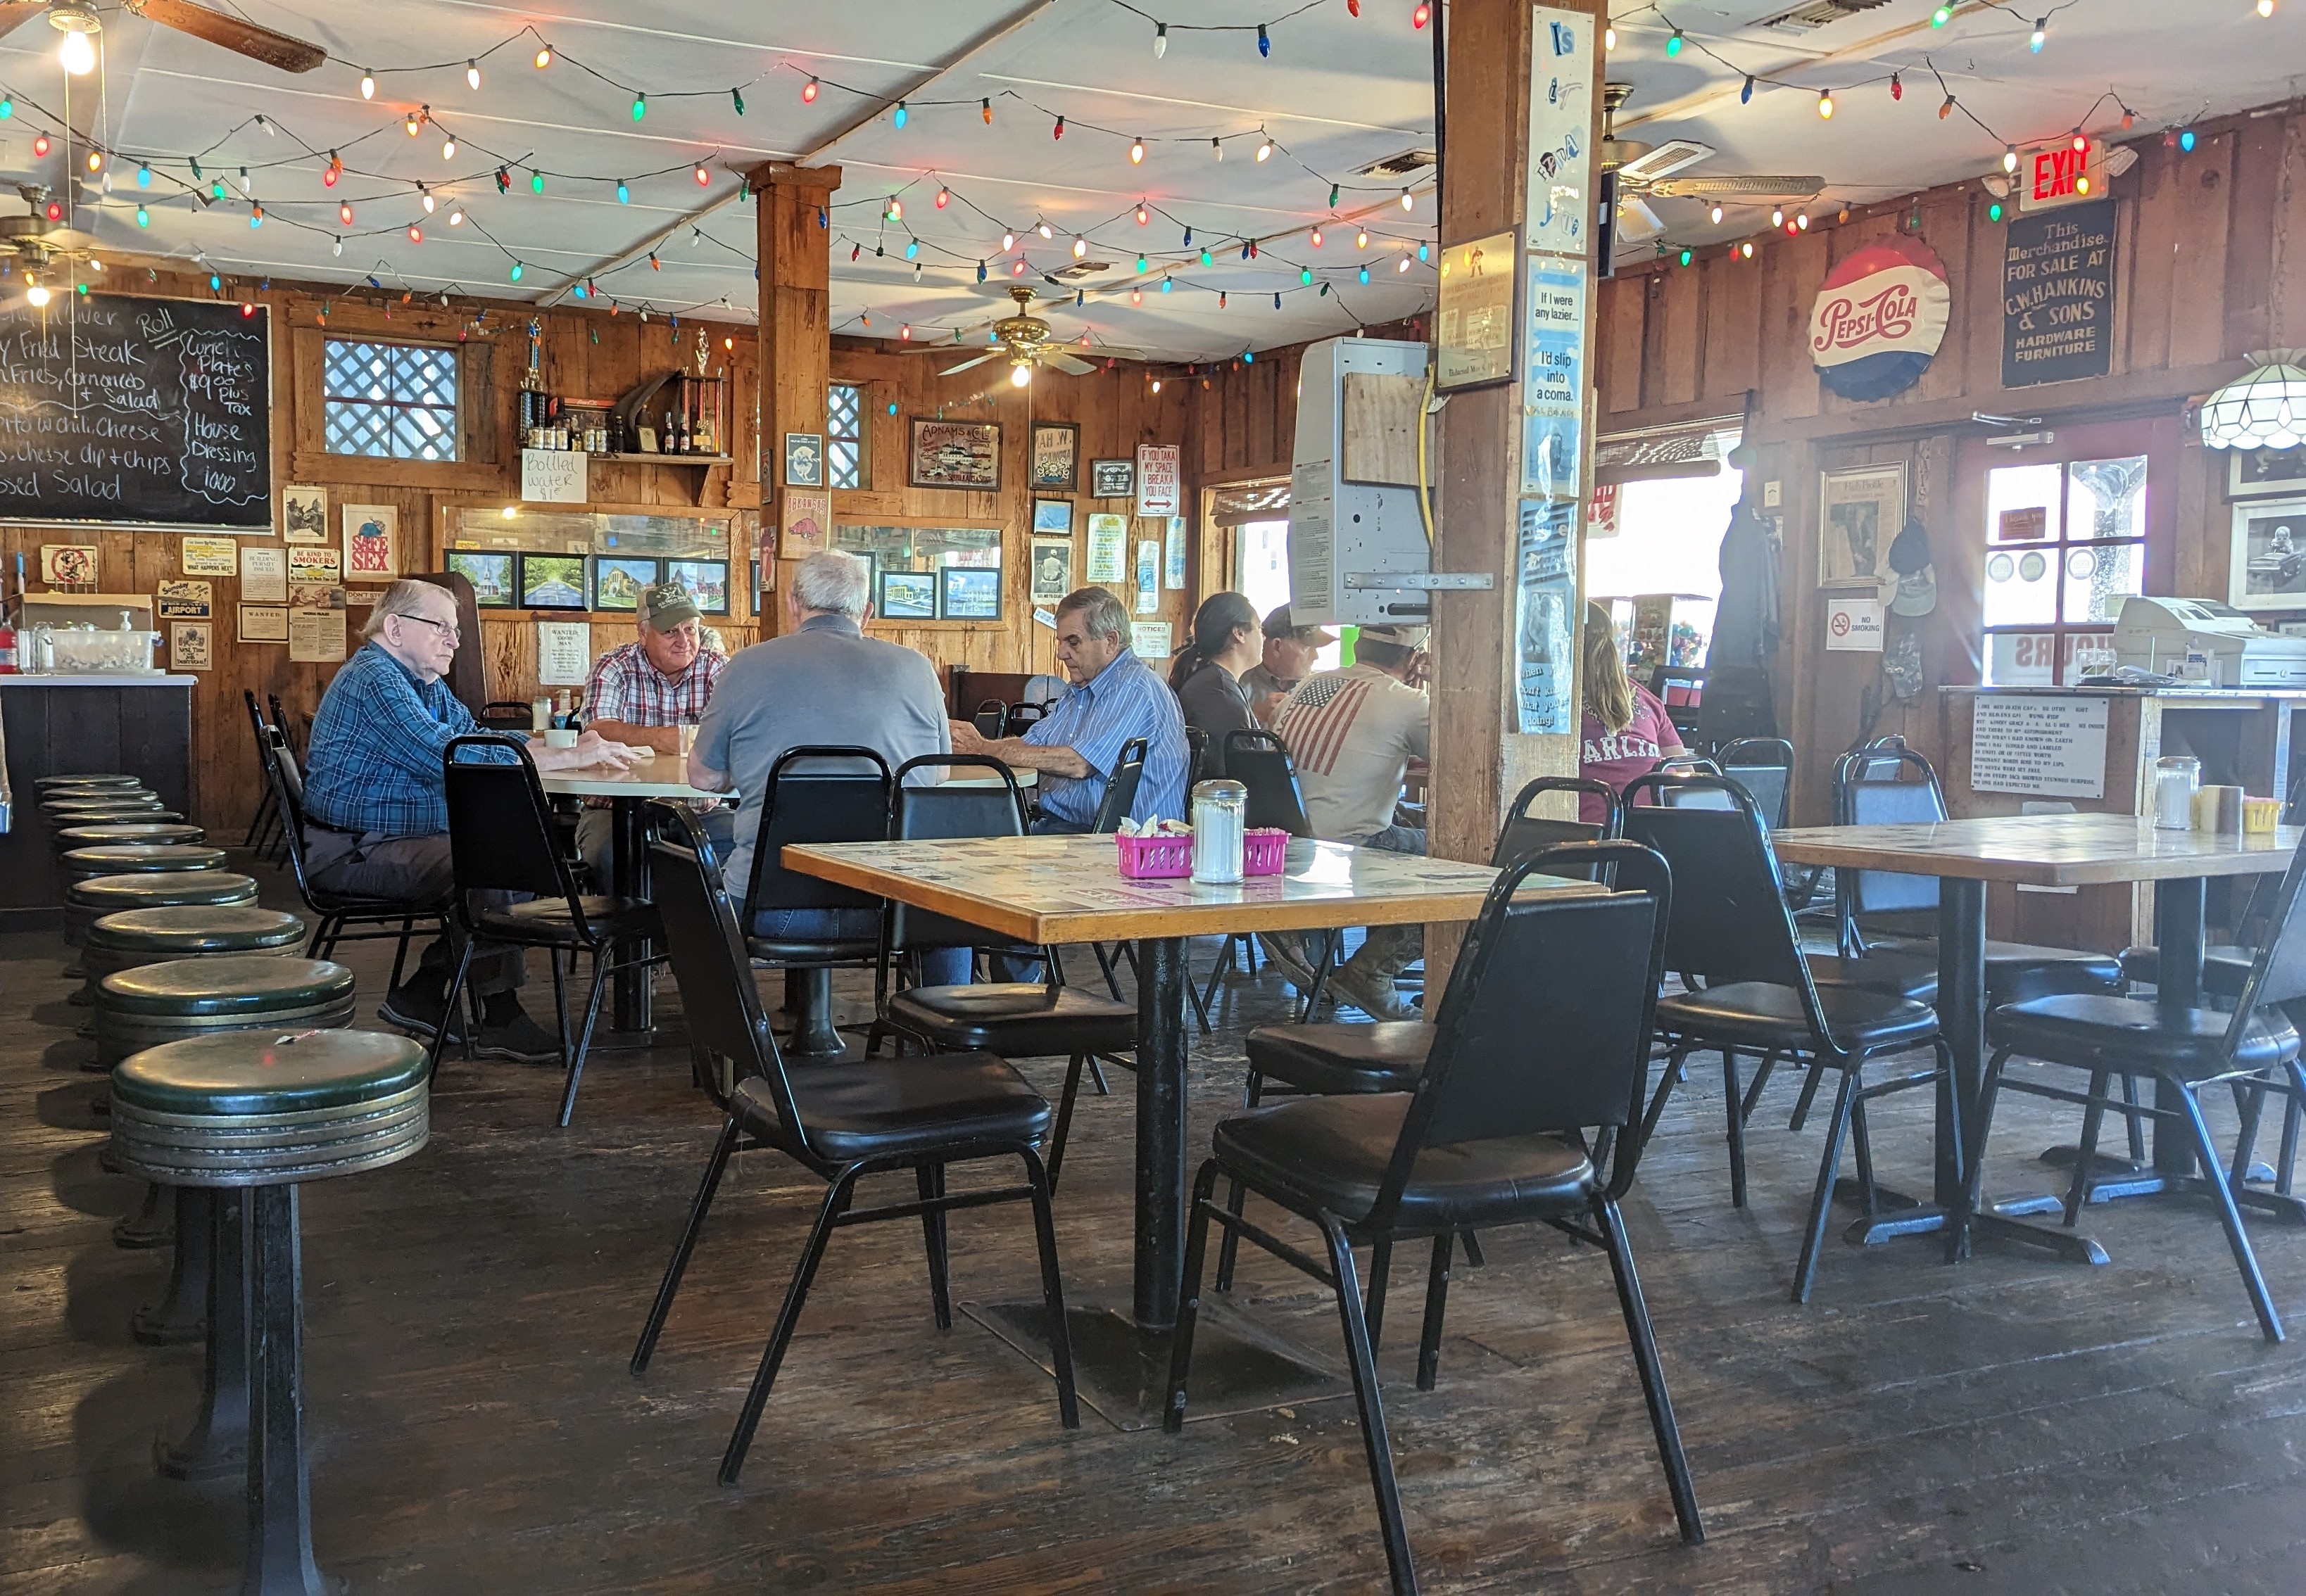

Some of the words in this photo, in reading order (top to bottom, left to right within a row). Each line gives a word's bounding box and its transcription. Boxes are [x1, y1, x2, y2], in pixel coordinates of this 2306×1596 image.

[2033, 145, 2092, 201] EXIT
[2044, 222, 2079, 239] This
[2008, 263, 2036, 281] FOR
[2041, 255, 2079, 275] SALE
[2087, 249, 2107, 268] AT
[1541, 292, 1548, 304] If
[1549, 293, 1552, 304] I
[1554, 297, 1573, 306] were
[1535, 308, 1549, 321] any
[2049, 300, 2096, 325] SONS
[2015, 326, 2096, 349] HARDWARE
[20, 330, 61, 360] Fried
[72, 334, 146, 366] Steak
[2015, 340, 2096, 362] FURNITURE
[1541, 350, 1552, 365] I'd
[1554, 353, 1572, 369] slip
[1546, 369, 1565, 384] into
[104, 387, 159, 410] Salad
[1537, 389, 1542, 400] a
[1544, 389, 1574, 402] coma.
[224, 401, 253, 417] Tax
[196, 412, 243, 441] House
[80, 443, 106, 469] dip
[192, 441, 257, 473] Dressing
[526, 452, 578, 474] Bottled
[1142, 450, 1147, 461] IF
[1148, 450, 1159, 461] YOU
[1161, 450, 1176, 462] TAKA
[1145, 462, 1153, 473] MY
[1155, 462, 1173, 474] SPACE
[53, 469, 122, 501] Salad
[1147, 474, 1174, 485] BREAKA
[1145, 486, 1157, 496] YOU
[1158, 486, 1172, 497] FACE
[786, 496, 826, 517] ARKANSAS
[352, 535, 389, 552] SAFE
[352, 550, 389, 571] SEX
[162, 583, 189, 595] Someday
[168, 606, 202, 614] AIRPORT
[1527, 715, 1554, 726] doing!
